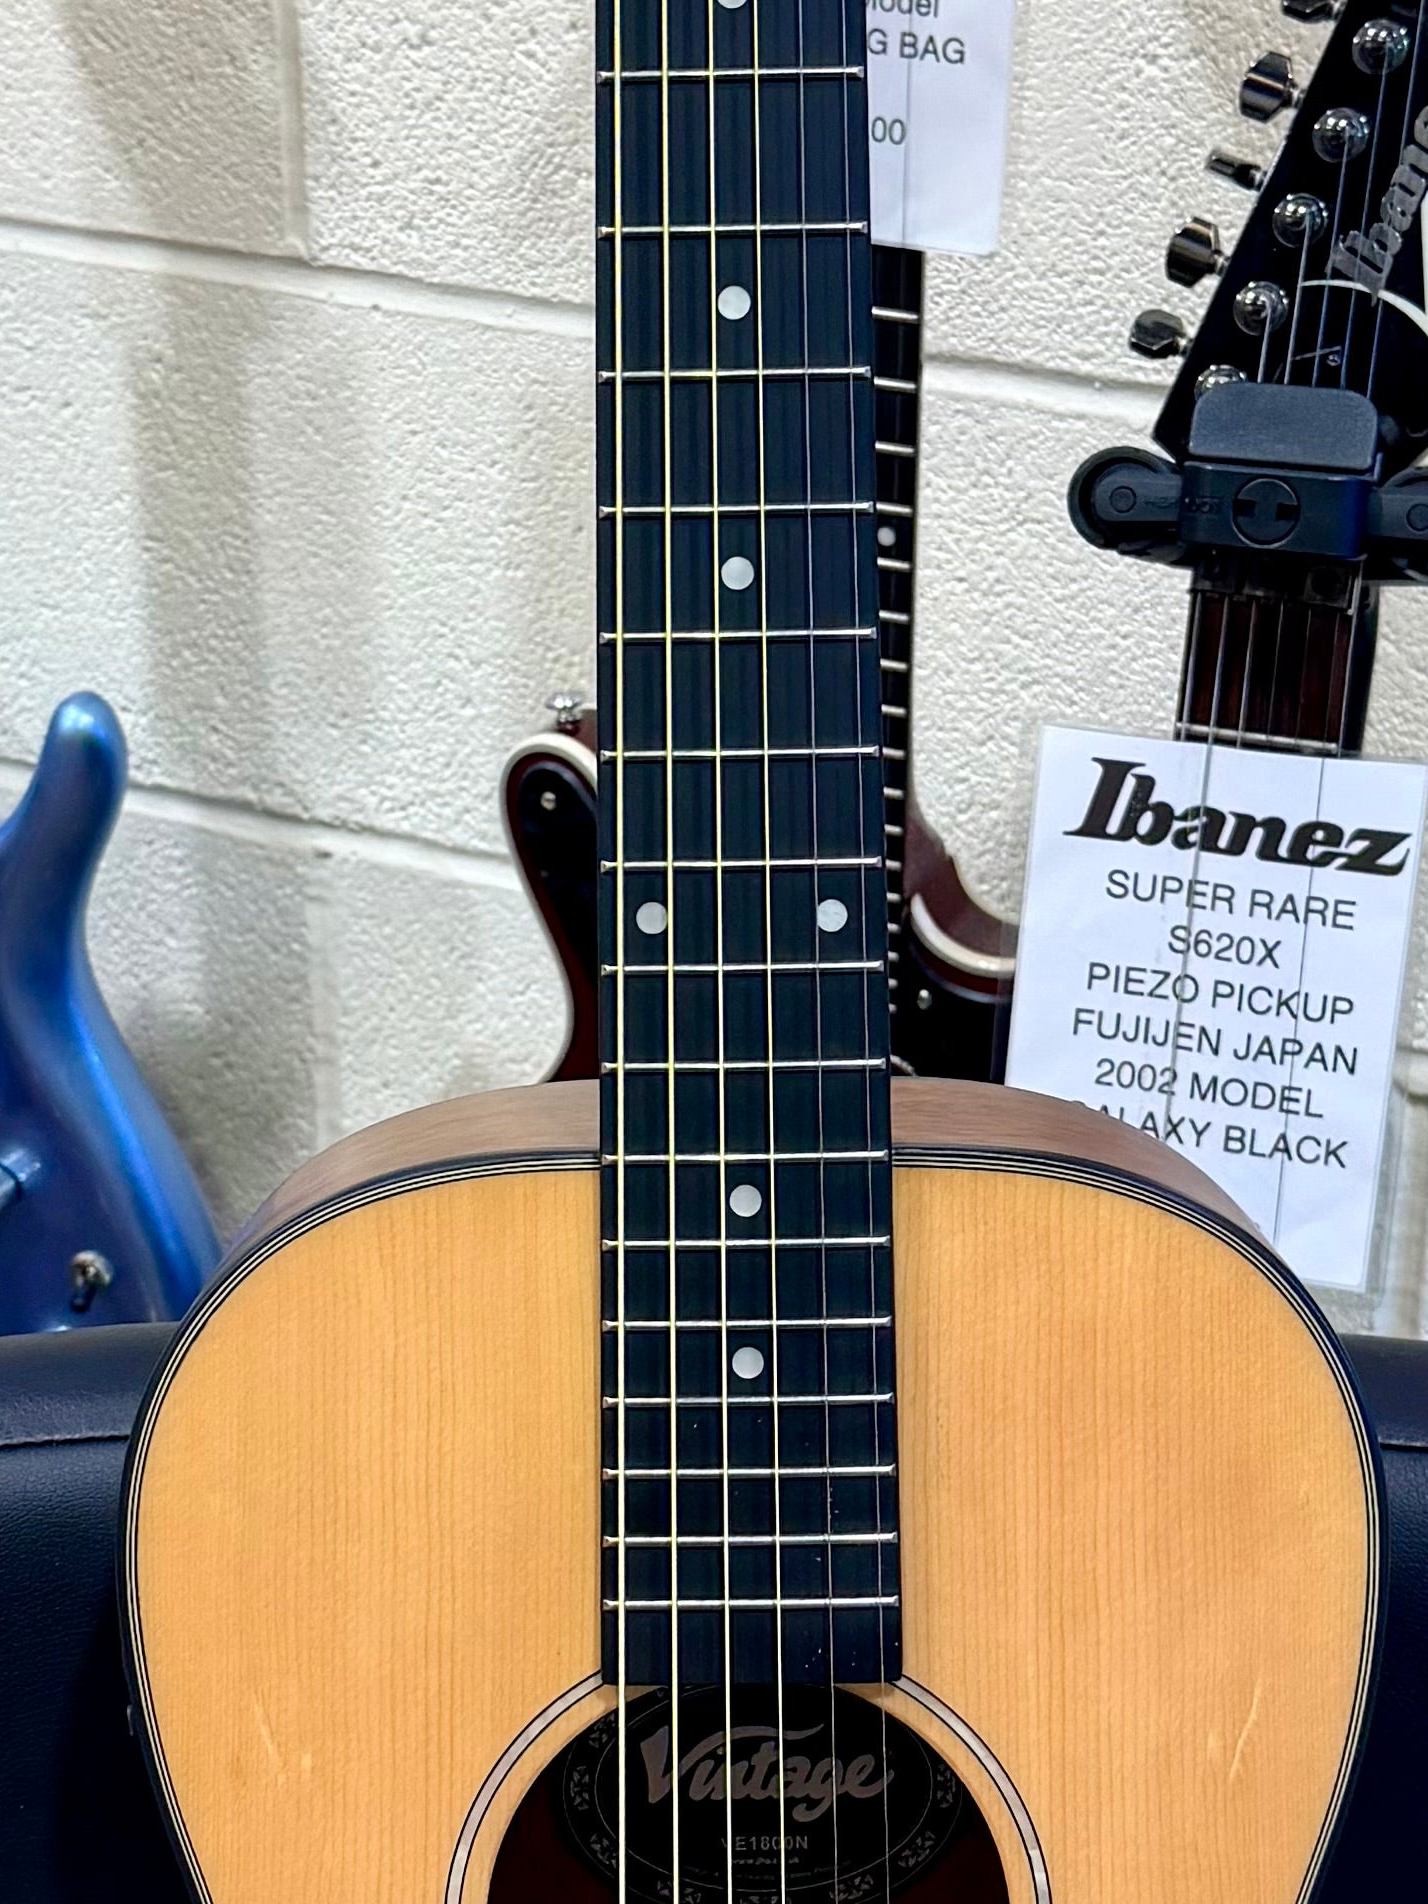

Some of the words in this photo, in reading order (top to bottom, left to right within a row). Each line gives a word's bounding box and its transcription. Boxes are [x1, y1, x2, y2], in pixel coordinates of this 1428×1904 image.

[899, 32, 967, 65] BAG
[1063, 756, 1413, 878] Ibanez
[1106, 869, 1235, 914] SUPER
[1249, 887, 1357, 931] RARE
[1168, 926, 1281, 969] S620X
[1087, 963, 1199, 1005] PIEZO
[1212, 982, 1355, 1024] PICKUP
[1072, 1007, 1222, 1057] FUJIJEN
[1233, 1034, 1359, 1076] JAPAN
[1094, 1059, 1178, 1097] 2002
[1189, 1073, 1323, 1119] MODEL
[1224, 1127, 1349, 1169] BLACK
[640, 1722, 895, 1823] Vintage
